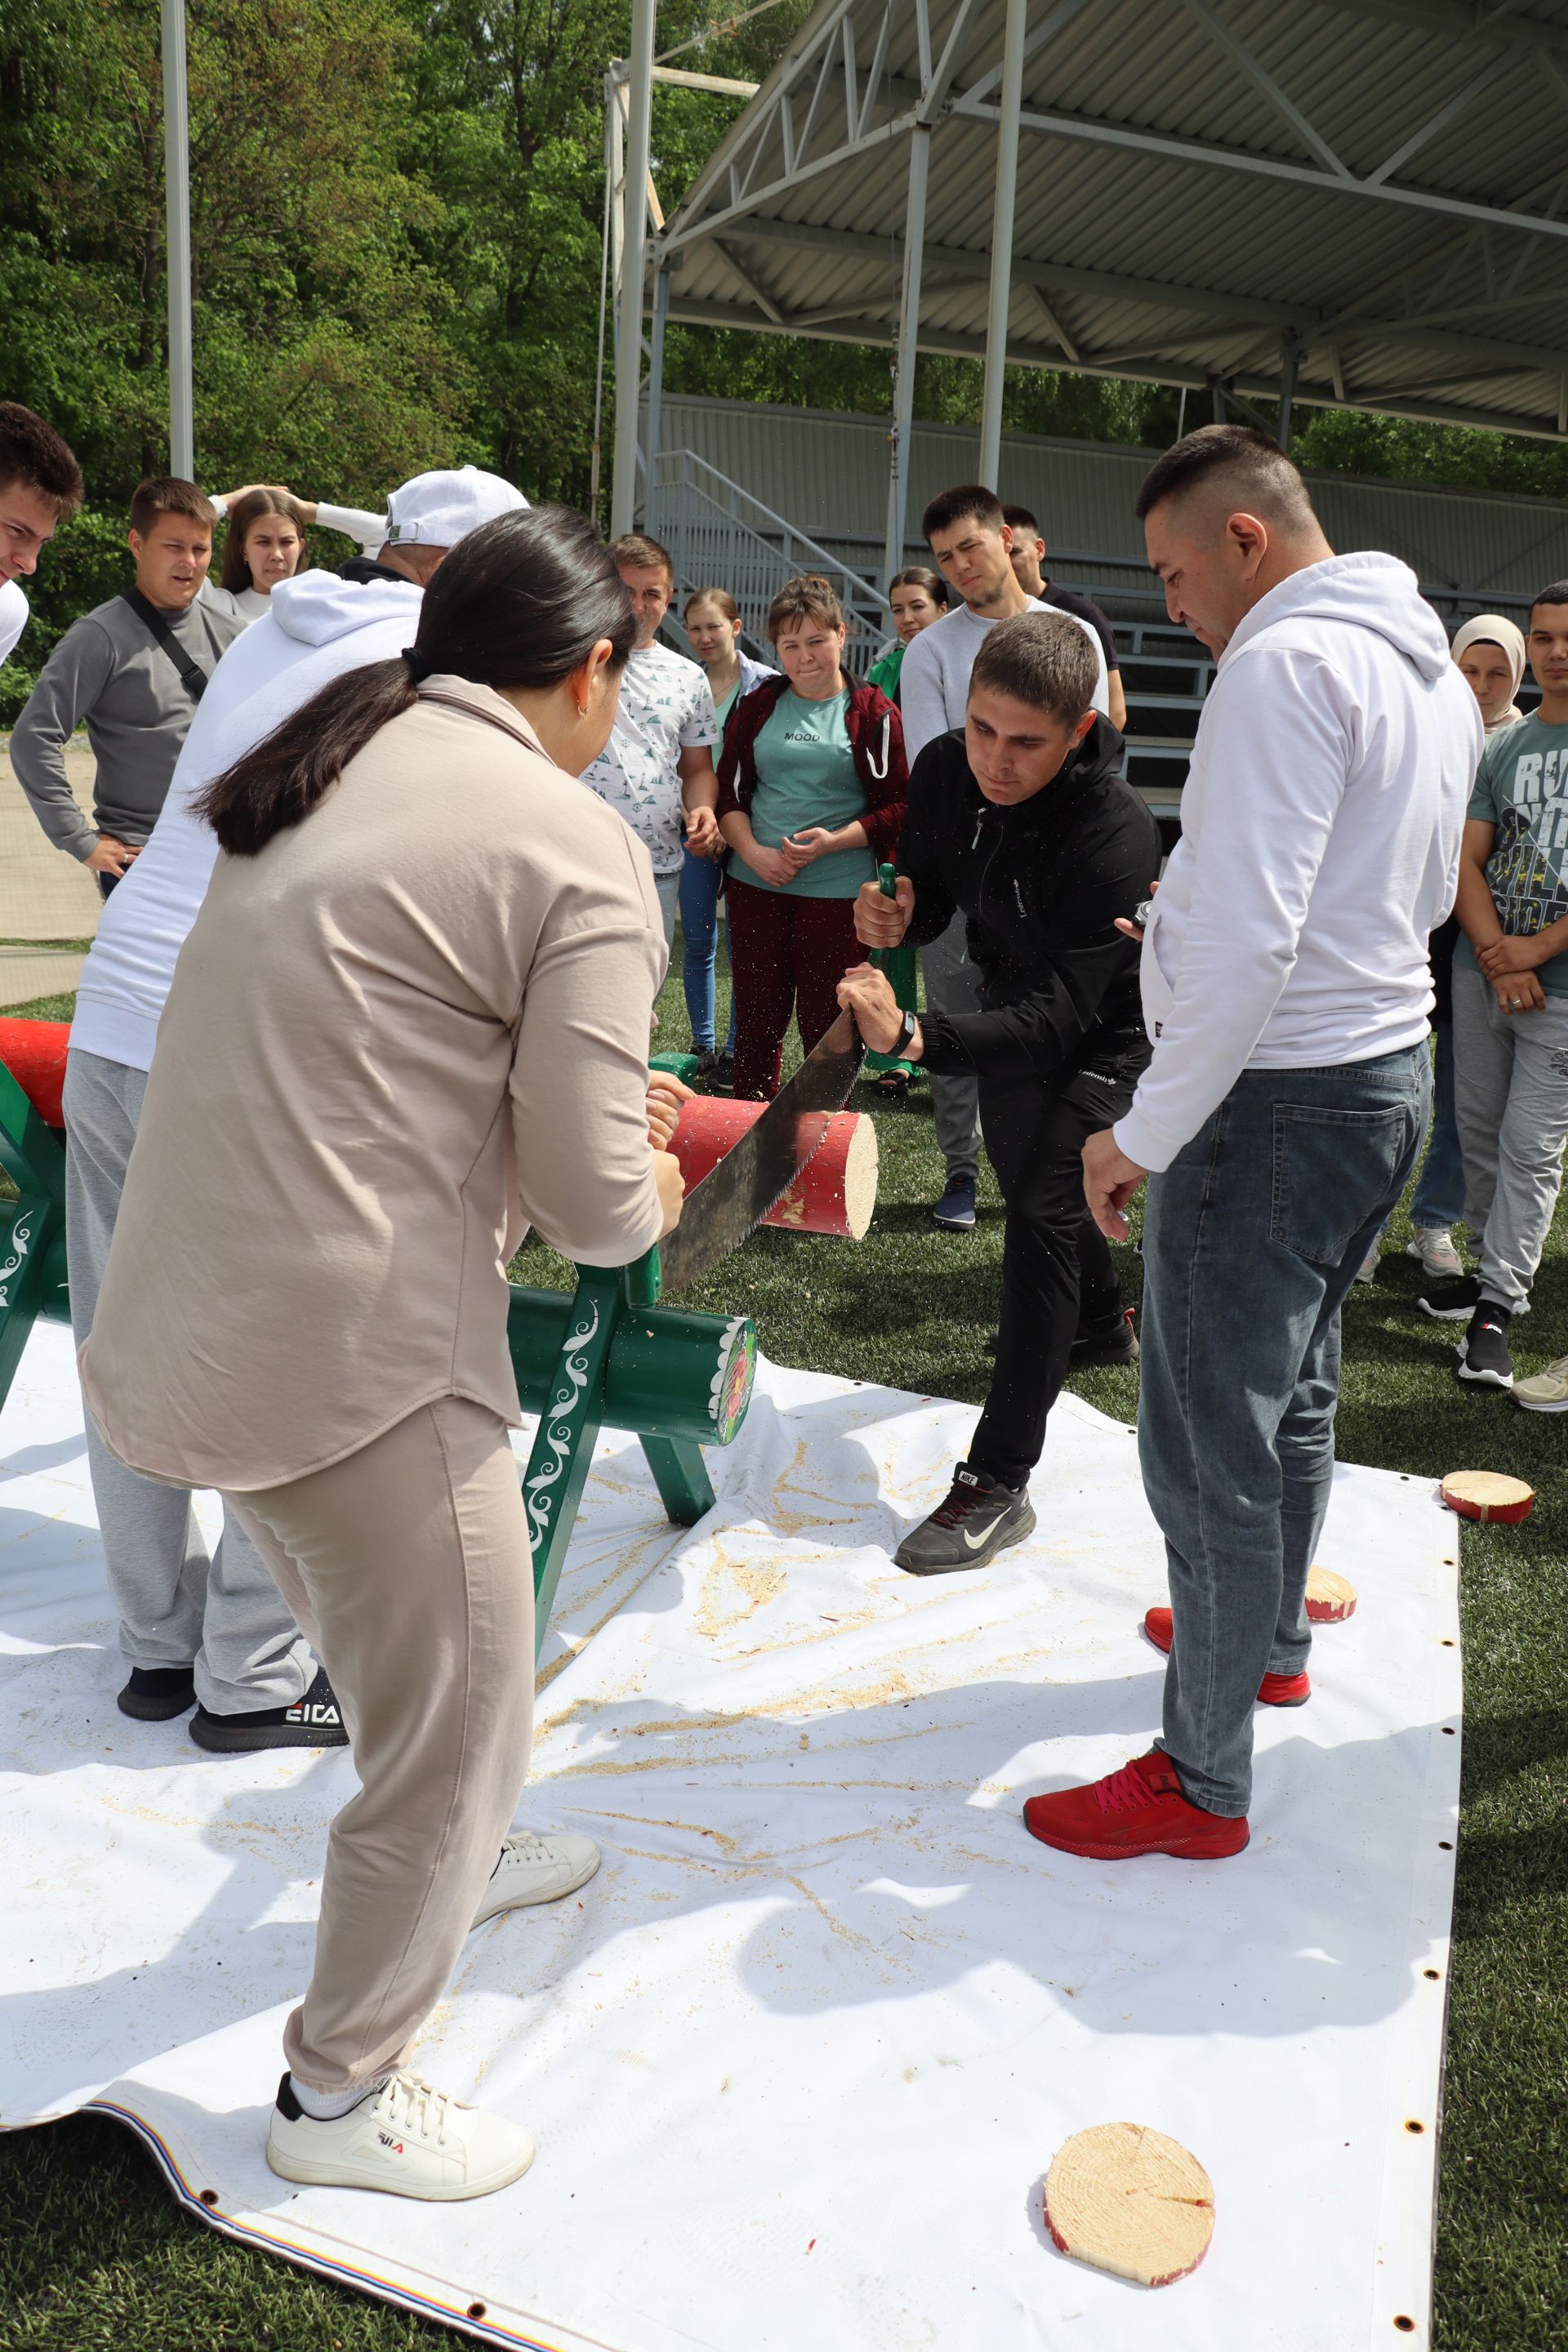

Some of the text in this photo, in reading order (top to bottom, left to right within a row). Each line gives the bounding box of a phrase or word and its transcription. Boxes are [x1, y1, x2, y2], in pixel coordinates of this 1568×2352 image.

[784, 733, 820, 742] MOOD
[1513, 748, 1568, 804] RU
[960, 1472, 976, 1485] NIKE
